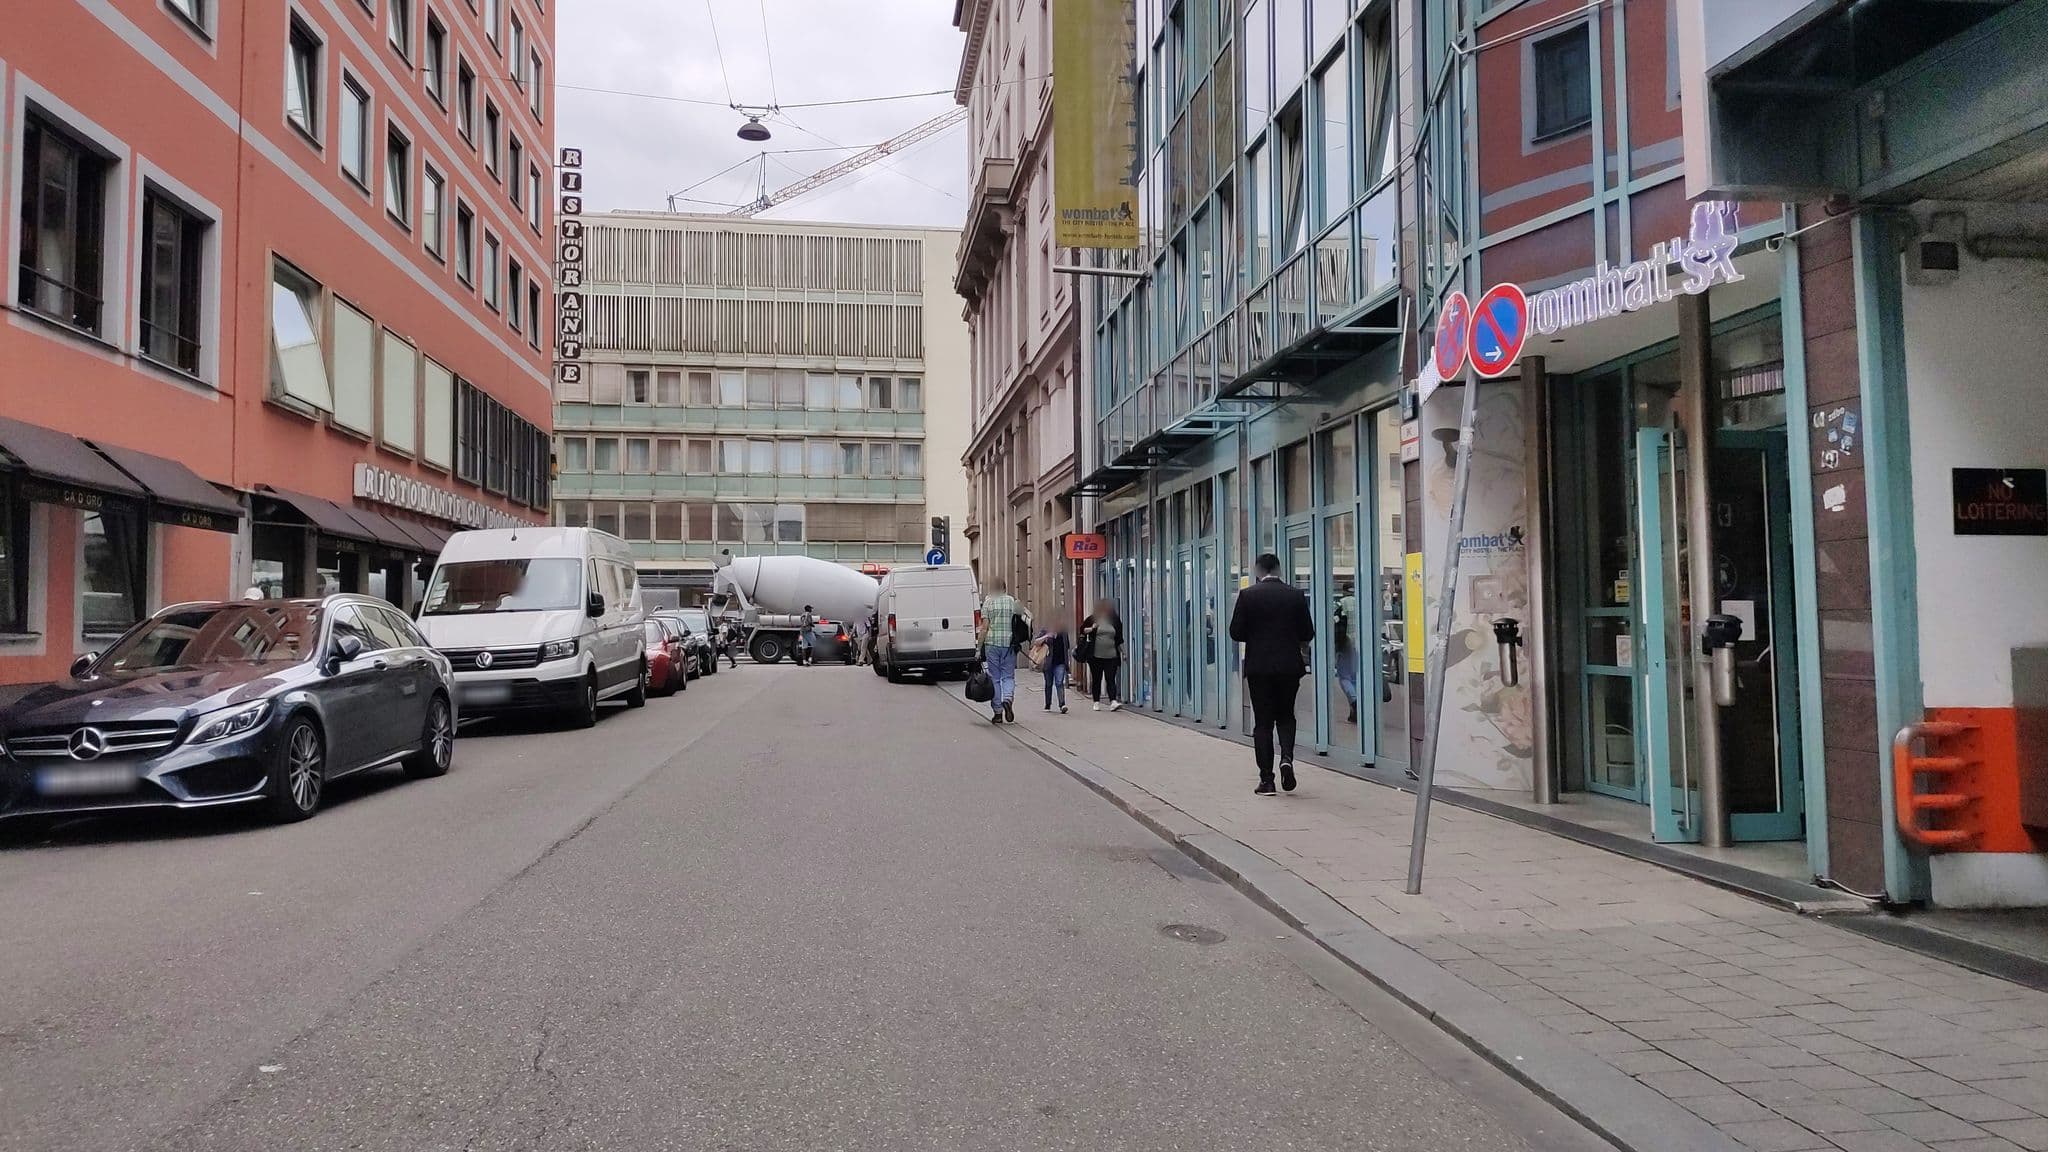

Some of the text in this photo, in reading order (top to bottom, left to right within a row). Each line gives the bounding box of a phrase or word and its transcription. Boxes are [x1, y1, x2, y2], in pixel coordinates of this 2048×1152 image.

[561, 150, 581, 380] RISTORANTE
[365, 468, 461, 519] RISTORANTE
[1988, 482, 2014, 500] NO
[1072, 536, 1098, 551] Ria
[1461, 533, 1519, 548] ombat's
